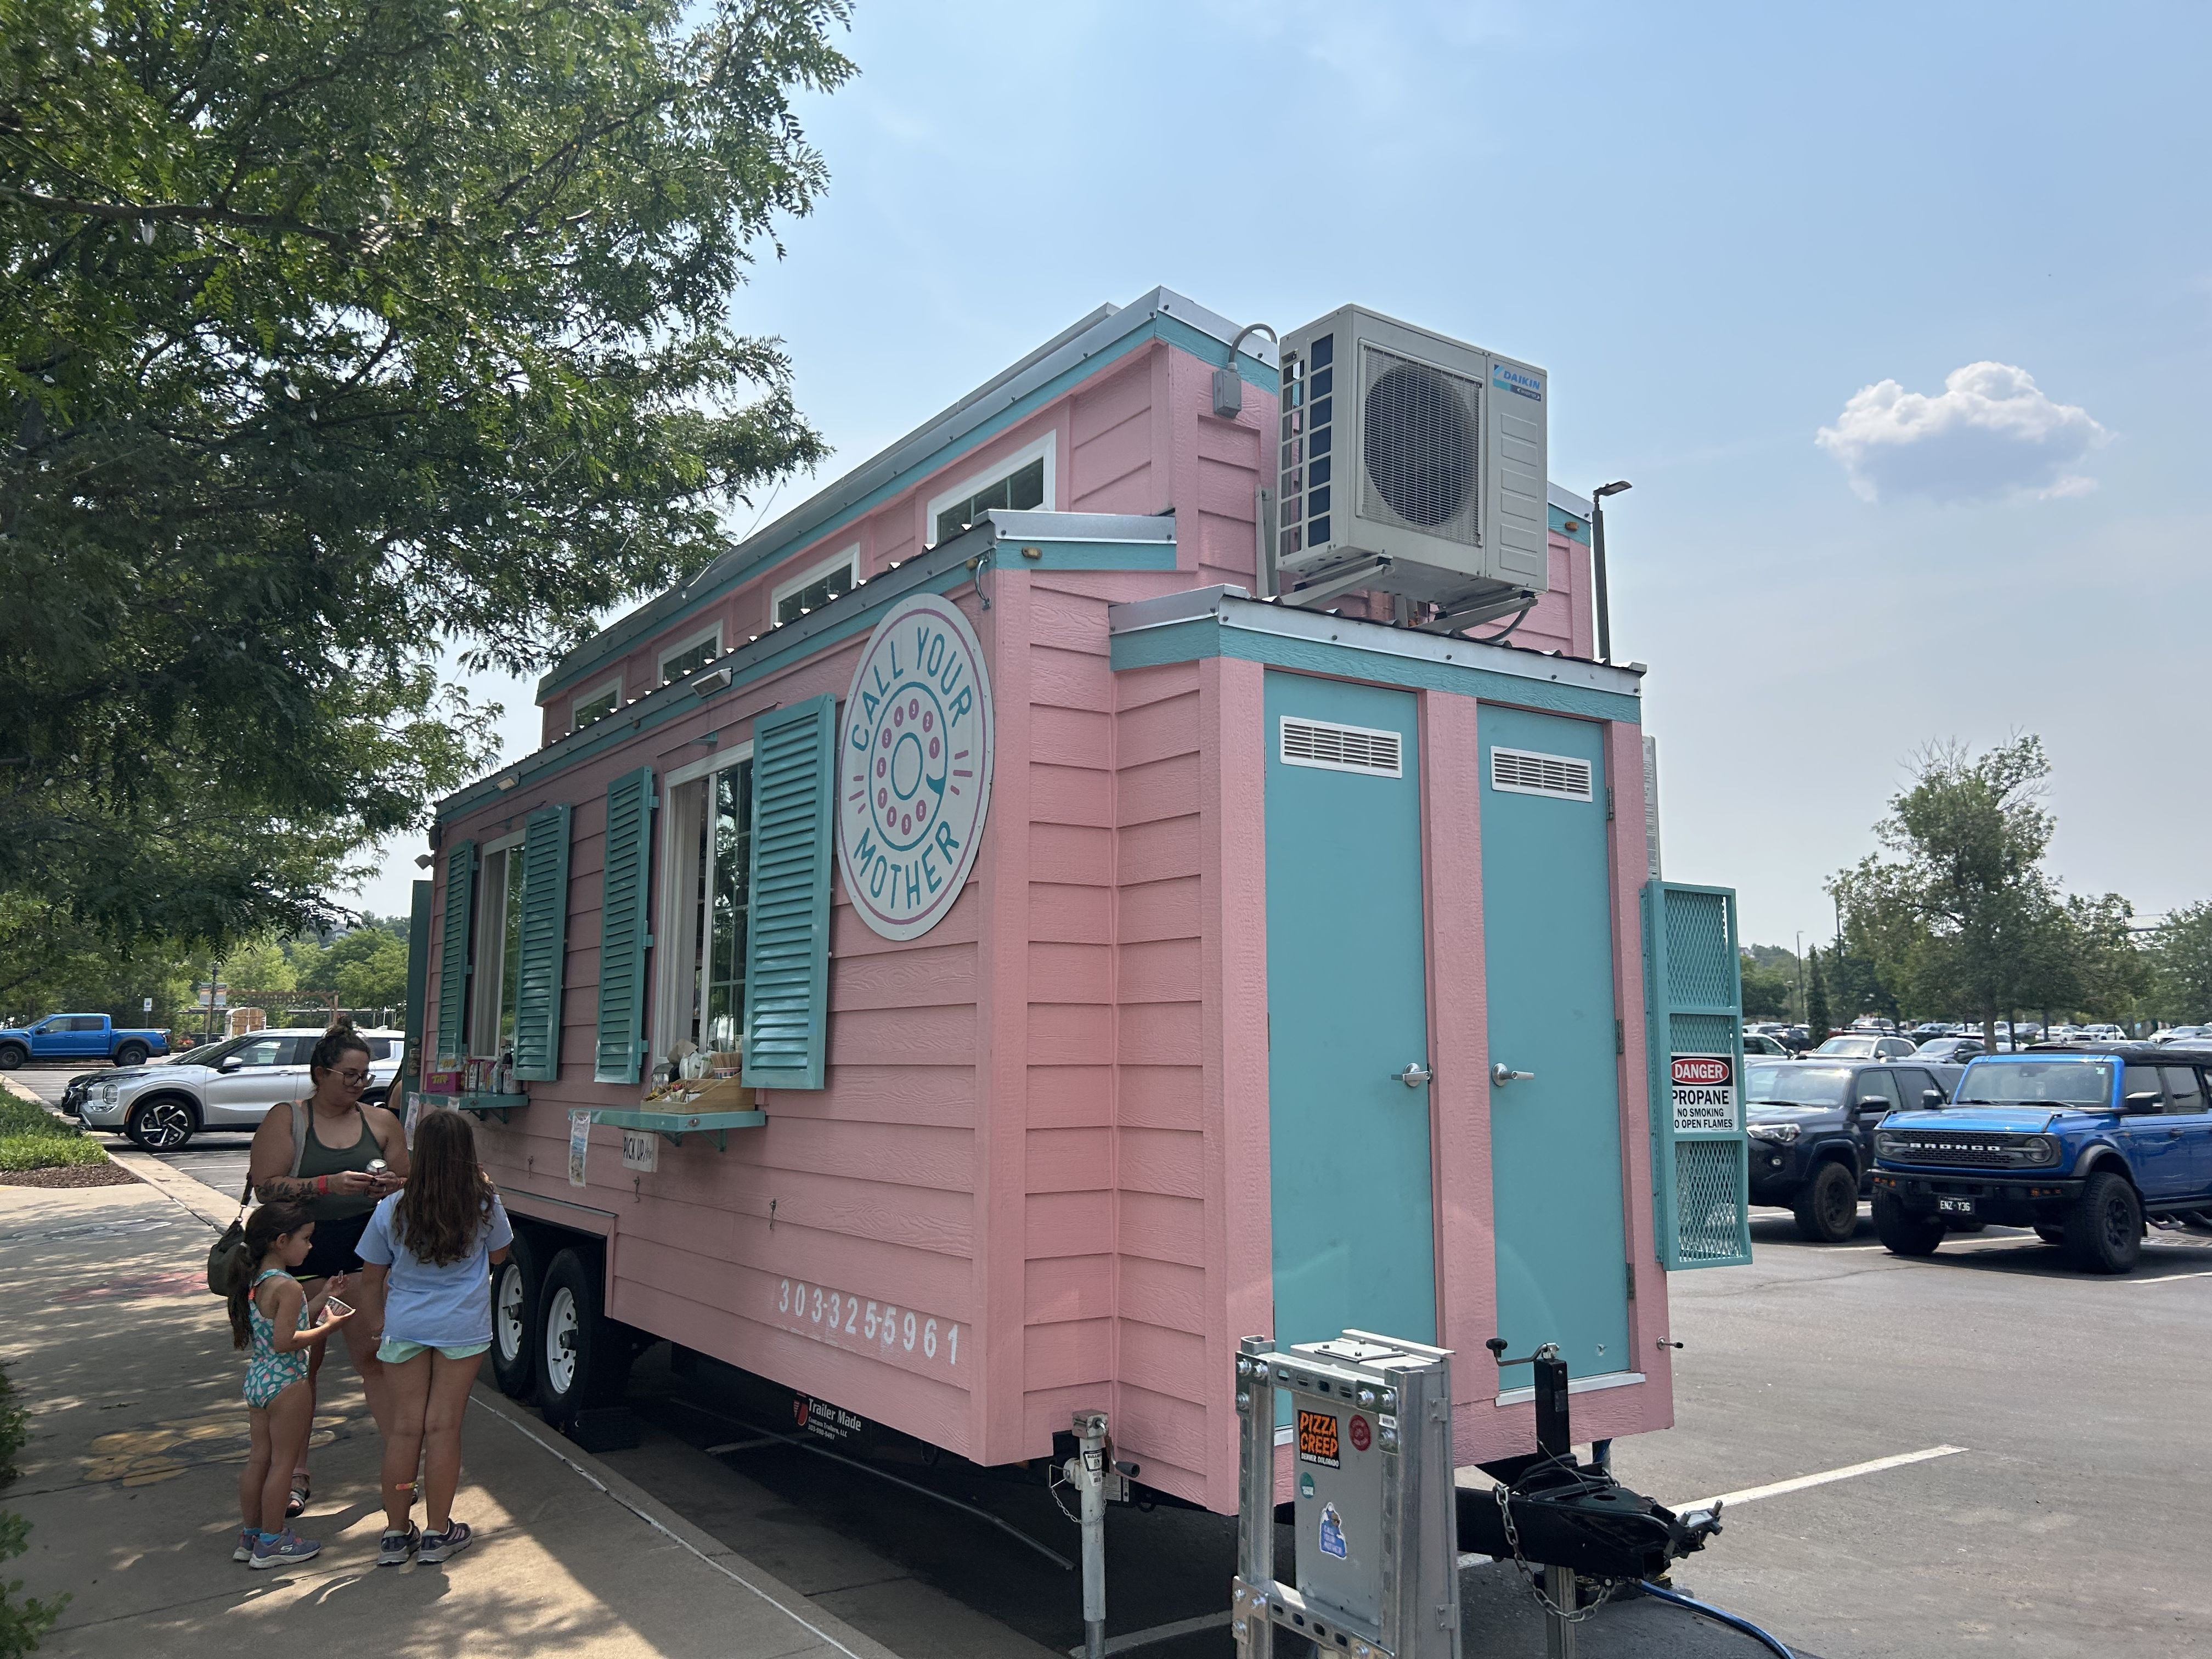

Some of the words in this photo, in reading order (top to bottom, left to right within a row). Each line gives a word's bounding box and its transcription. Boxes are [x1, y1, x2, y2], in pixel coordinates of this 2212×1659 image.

[1503, 370, 1540, 390] DAIKIN
[851, 640, 904, 752] CALL
[917, 627, 972, 728] YOUR
[854, 821, 960, 910] MOTHER
[1674, 1064, 1723, 1079] DANGER
[1672, 1090, 1729, 1105] PROPANE
[1677, 1108, 1688, 1118] NO
[1689, 1108, 1724, 1118] SMOKING
[1674, 1119, 1680, 1128] O
[1681, 1119, 1701, 1128] OPEN
[1703, 1119, 1733, 1128] FLAMES
[1910, 1143, 2000, 1152] BRONCO
[808, 1397, 836, 1421] Trailer
[837, 1409, 862, 1432] Made
[1300, 1412, 1337, 1438] PIZZA
[1300, 1432, 1338, 1458] CREEP
[1301, 1452, 1317, 1463] DENVER
[1317, 1456, 1339, 1468] COLORADO
